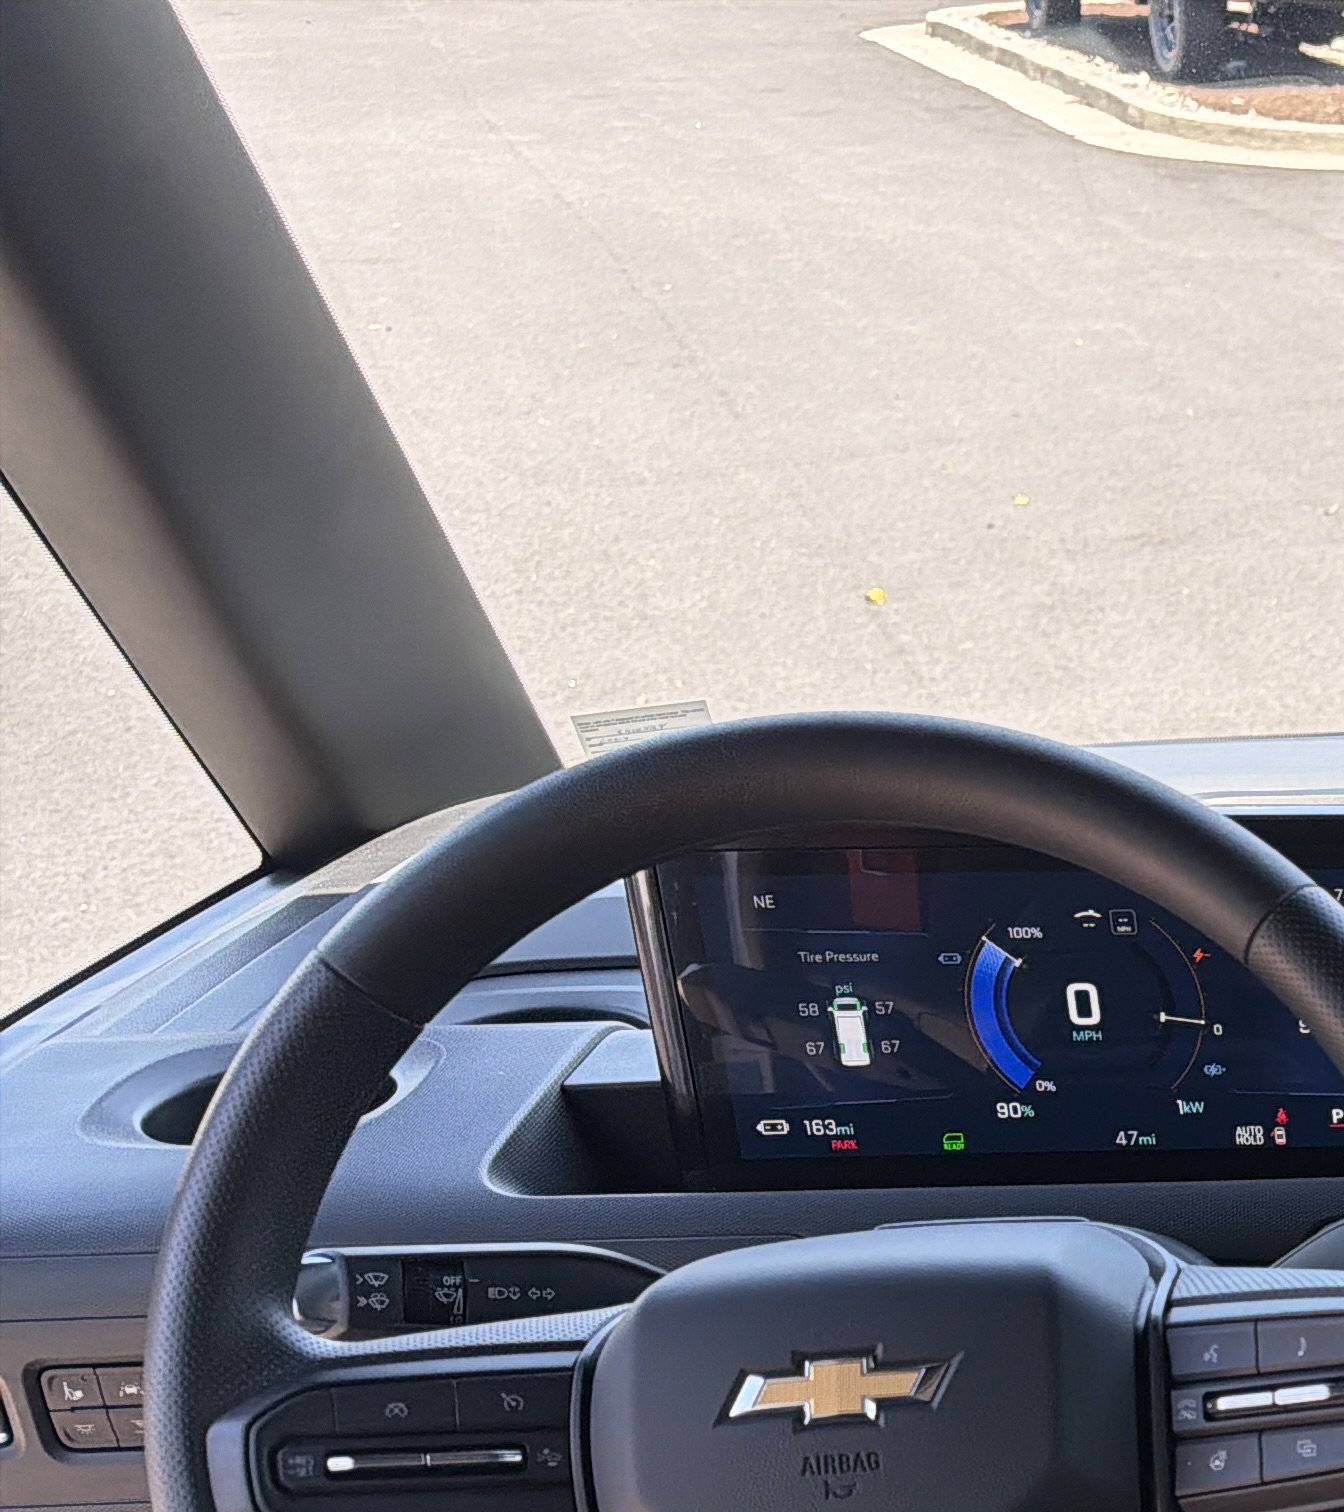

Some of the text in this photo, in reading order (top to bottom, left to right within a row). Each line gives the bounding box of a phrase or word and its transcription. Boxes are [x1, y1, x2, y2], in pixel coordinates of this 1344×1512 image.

[753, 894, 776, 910] NE
[1007, 926, 1044, 939] 100%
[797, 951, 880, 963] Tire Pressure
[834, 982, 854, 996] psi
[798, 1003, 820, 1017] 58
[874, 1001, 895, 1015] 57
[1065, 982, 1102, 1026] 0
[1072, 1030, 1103, 1043] MPH
[1213, 1023, 1223, 1036] 0
[805, 1042, 825, 1056] 67
[881, 1040, 901, 1055] 67
[1035, 1079, 1057, 1092] 0%
[996, 1102, 1036, 1119] 90%
[1331, 1108, 1344, 1125] P
[1235, 1125, 1264, 1136] AUTO
[831, 1139, 859, 1151] PARK
[1235, 1134, 1265, 1146] HOLD
[442, 1275, 463, 1286] OFF
[800, 1450, 882, 1478] AIRBAG
